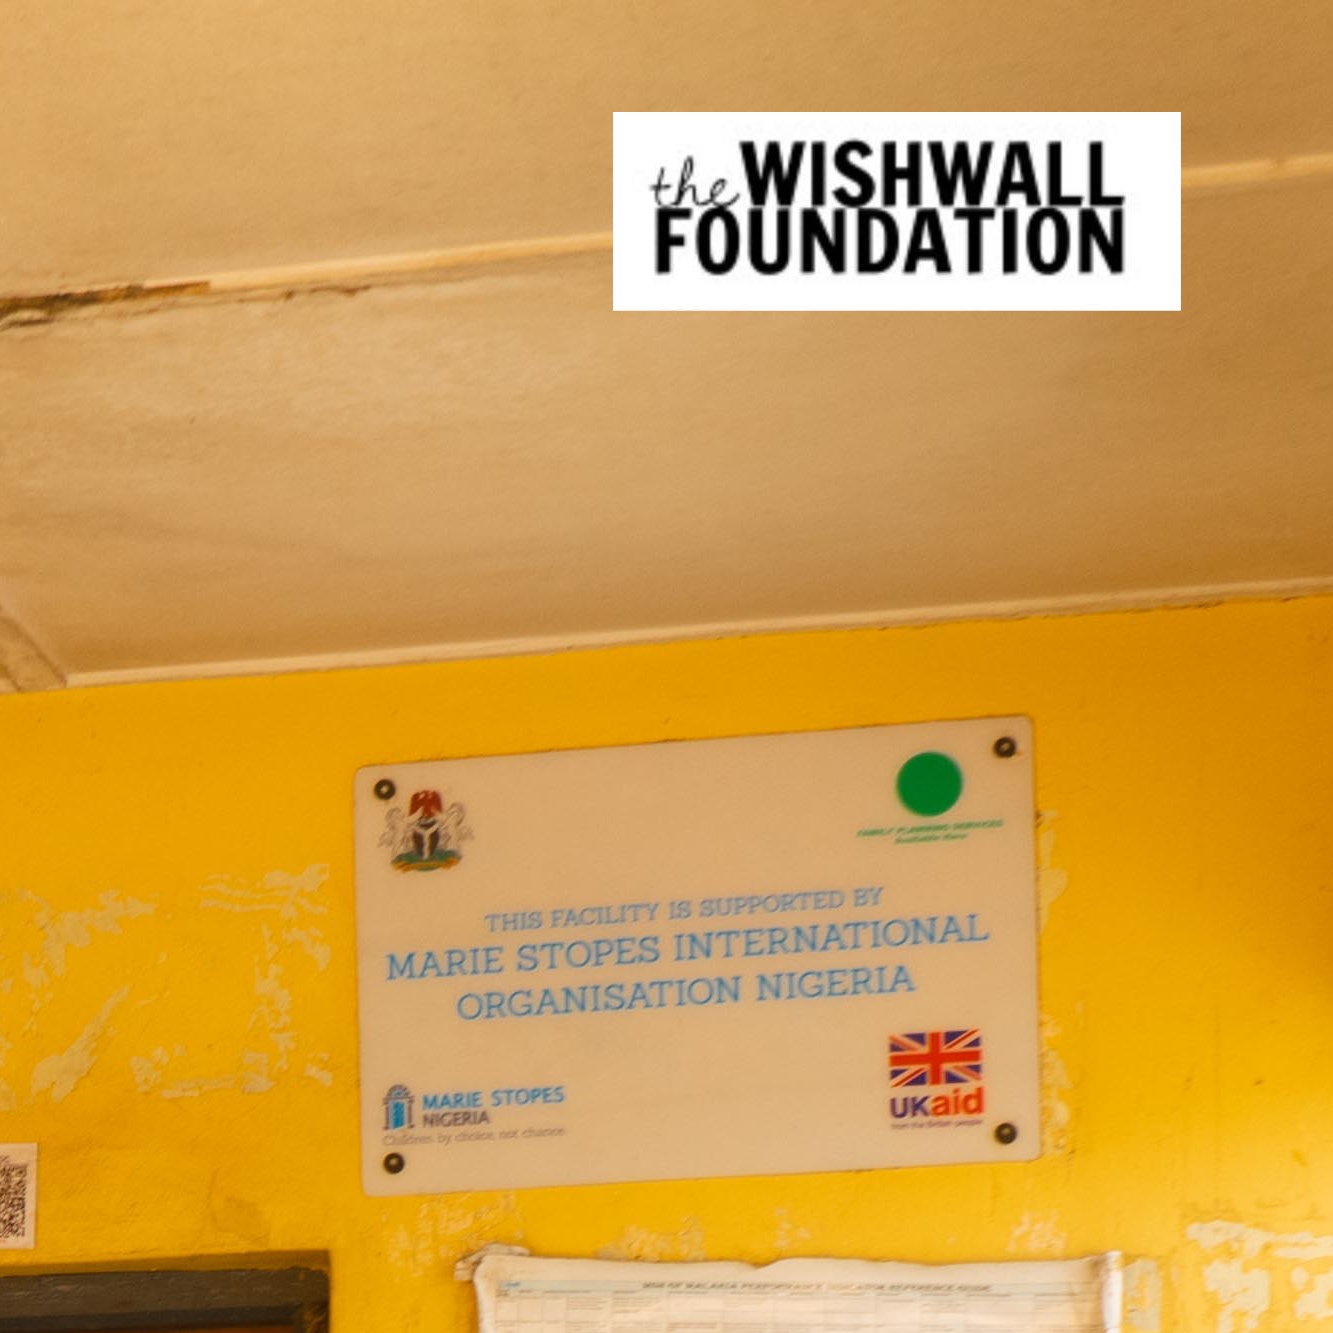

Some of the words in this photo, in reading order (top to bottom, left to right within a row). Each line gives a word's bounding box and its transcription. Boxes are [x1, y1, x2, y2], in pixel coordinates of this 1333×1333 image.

[485, 910, 542, 933] THIS
[551, 902, 660, 929] FACILITY
[669, 900, 691, 921] IS
[700, 890, 844, 919] SUPPORTED
[853, 886, 883, 908] BY
[386, 946, 503, 980] MARIE
[517, 935, 659, 972] STOPES
[674, 913, 989, 962] INTERNATIONAL
[457, 975, 739, 1021] ORGANISATION
[757, 965, 915, 1002] NIGERIA
[423, 1092, 482, 1110] MARIE
[491, 1086, 565, 1107] STOPES
[890, 1087, 985, 1118] UKaid
[423, 1111, 490, 1128] NIGERIA
